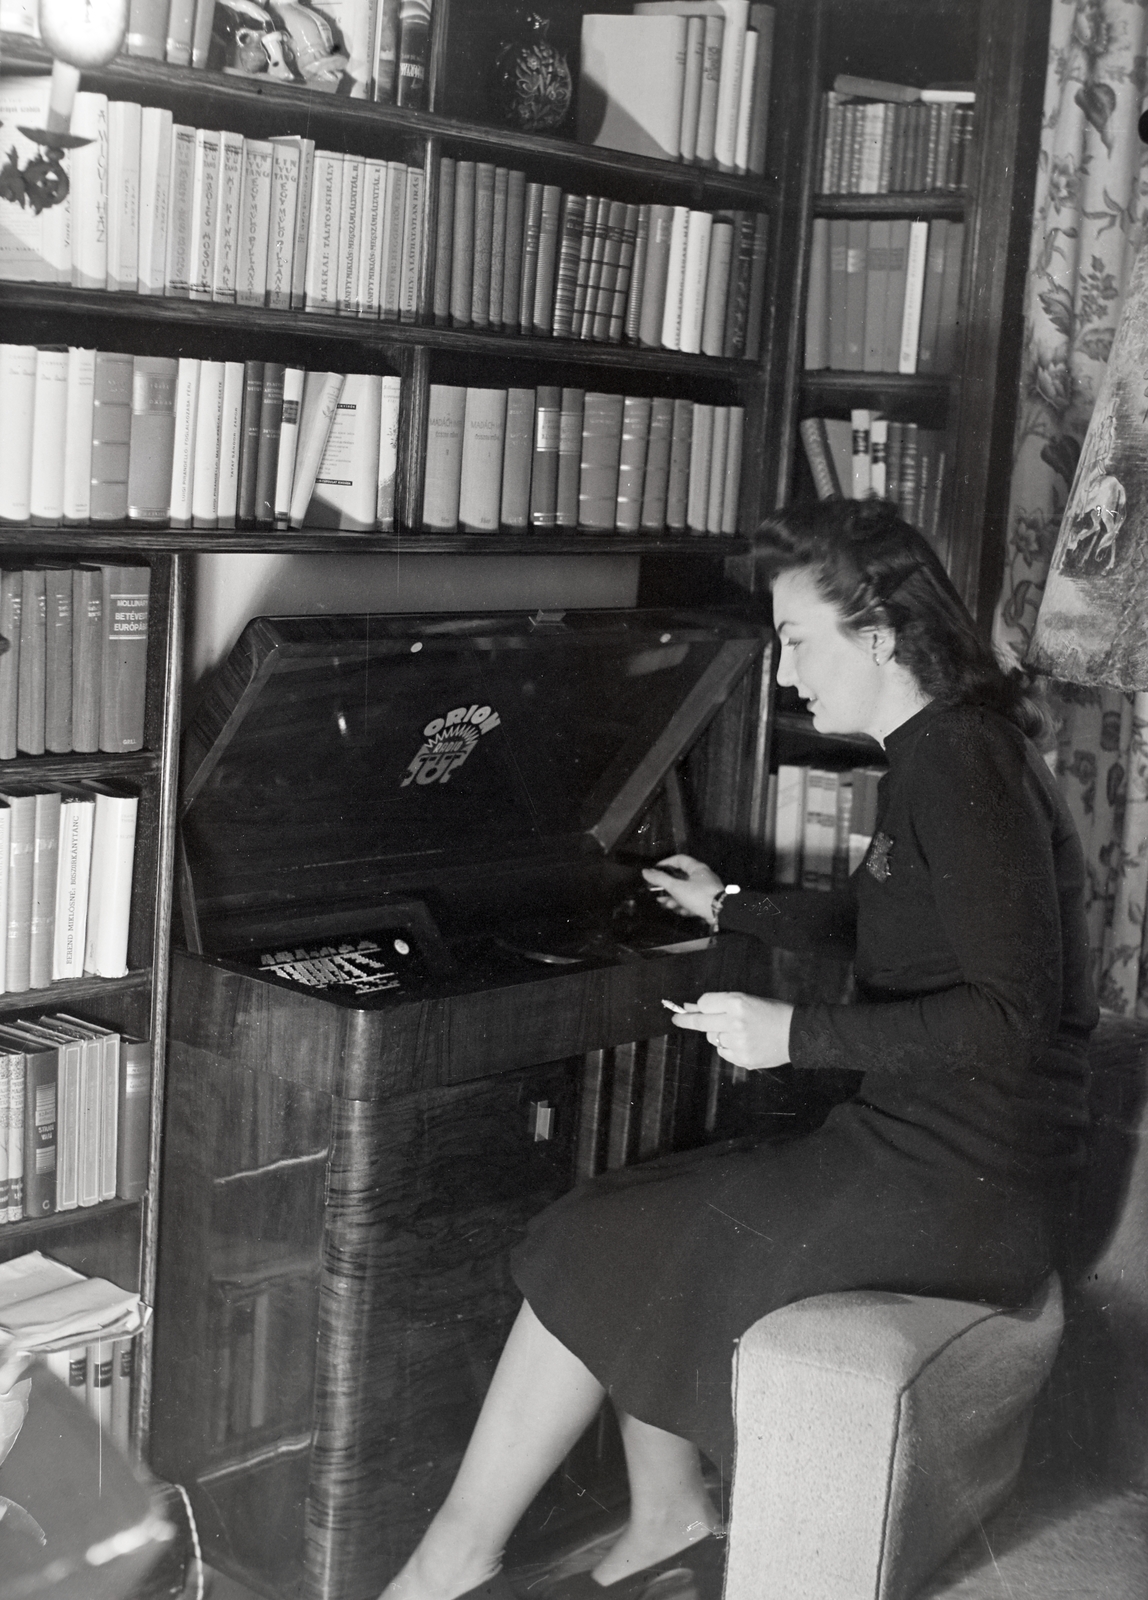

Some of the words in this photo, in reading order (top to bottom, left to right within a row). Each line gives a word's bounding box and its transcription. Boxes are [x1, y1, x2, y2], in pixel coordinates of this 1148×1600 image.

[246, 153, 267, 162] LIN
[275, 158, 296, 167] LIN
[245, 168, 269, 178] TANG
[274, 172, 296, 182] TANG
[322, 162, 334, 248] TÁLTOSKIRÁLY
[320, 252, 330, 303] MAKKAI:
[423, 704, 501, 736] ORION
[433, 741, 464, 753] RADIO
[67, 887, 76, 932] MIKLÓSNÉ:
[65, 934, 74, 965] BEREND
